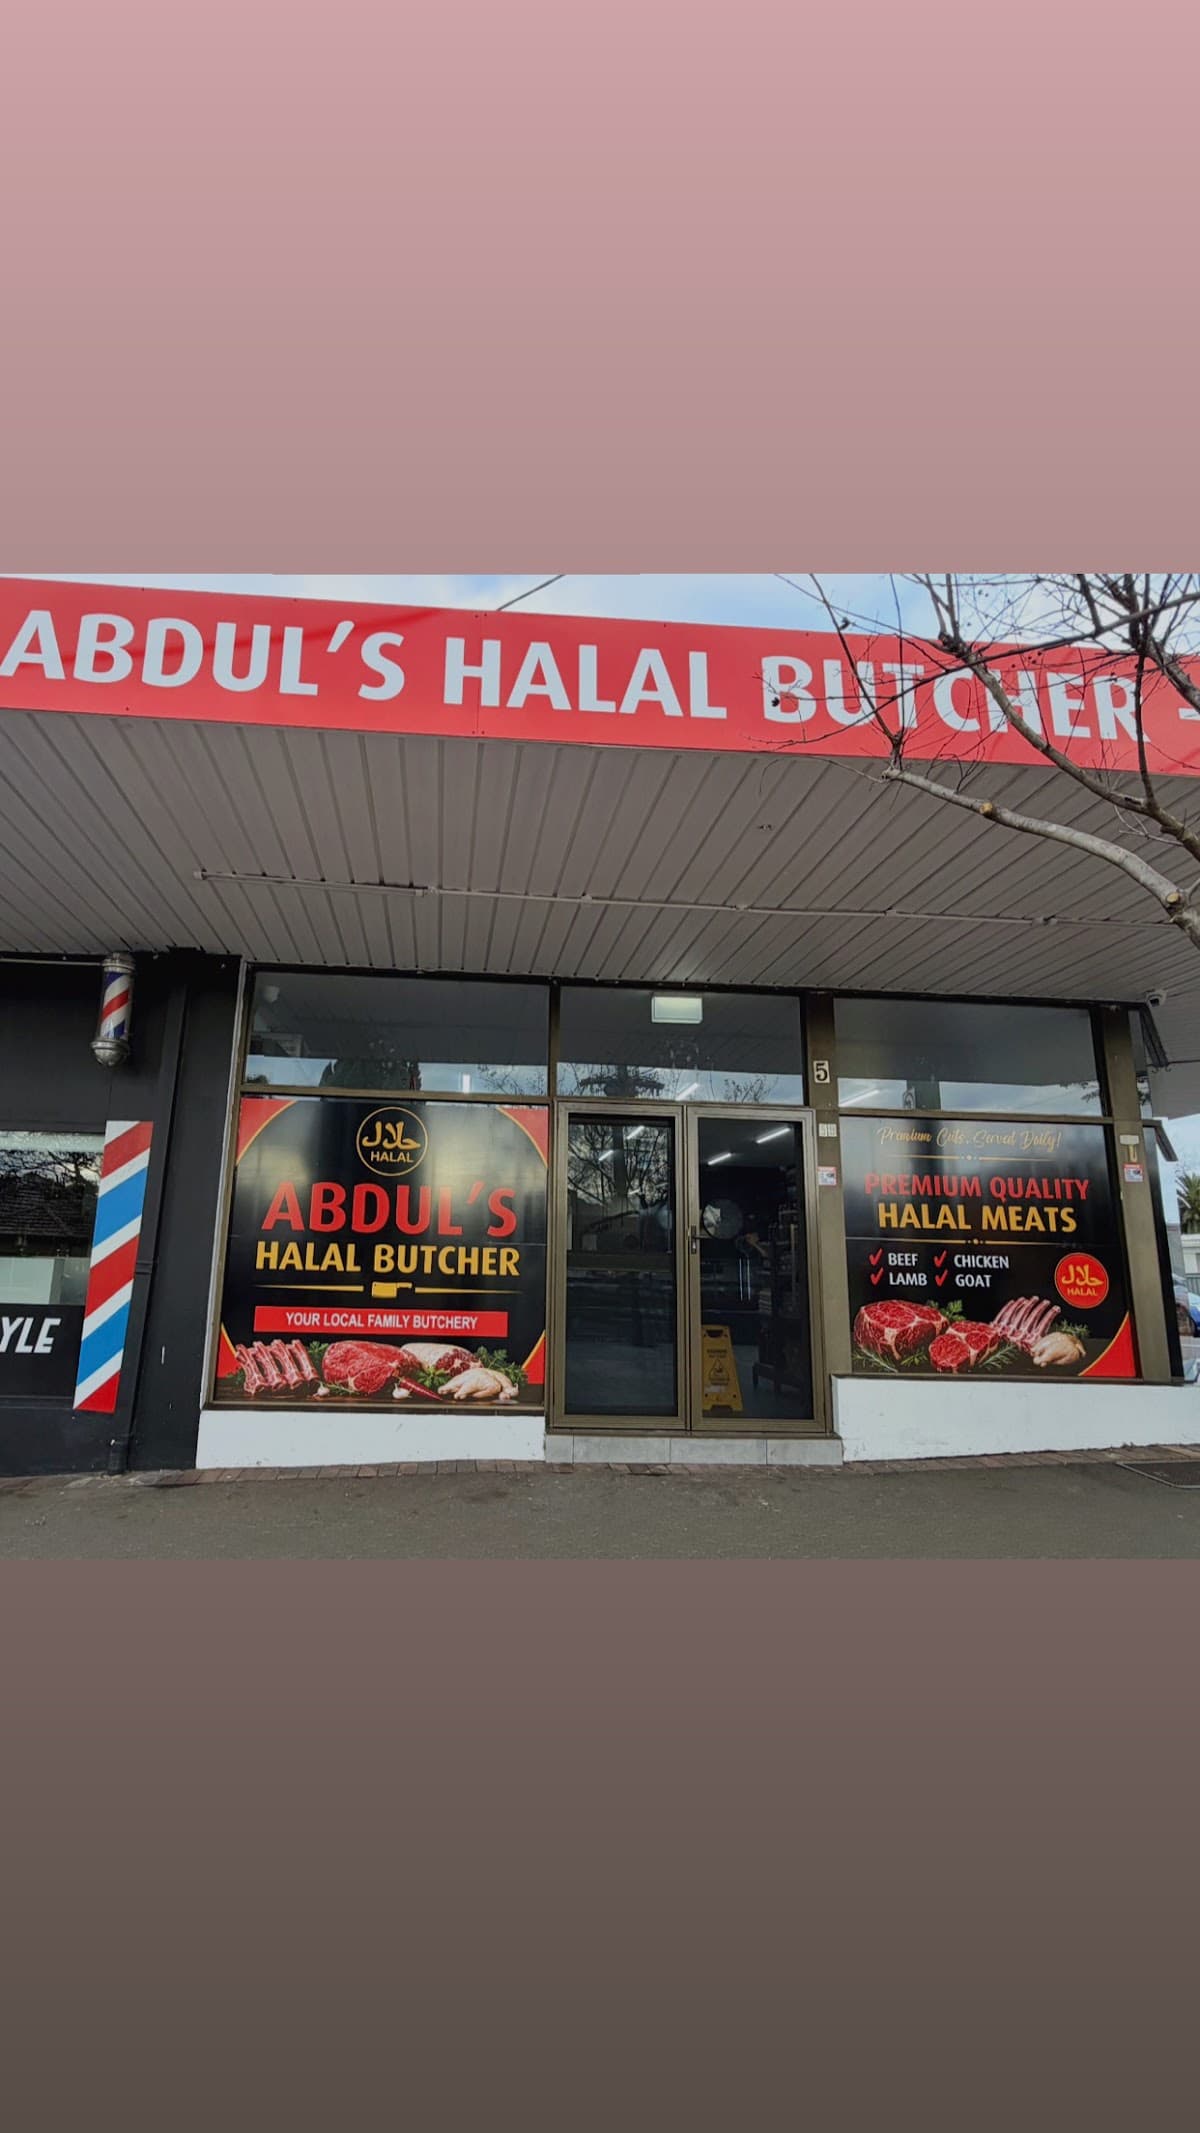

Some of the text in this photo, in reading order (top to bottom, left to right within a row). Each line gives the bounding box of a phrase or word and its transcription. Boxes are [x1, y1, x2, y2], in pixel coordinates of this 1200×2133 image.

[443, 637, 727, 720] HALAL
[761, 655, 1151, 742] BUTCHER
[815, 1062, 829, 1082] 5
[362, 1120, 422, 1150] حلال
[877, 1127, 932, 1145] Premium
[973, 1129, 1017, 1148] Served
[370, 1150, 414, 1164] HALAL
[864, 1171, 982, 1198] PREMIUM
[989, 1176, 1090, 1203] QUALITY
[878, 1202, 1077, 1233] HALAL MEATS
[255, 1240, 521, 1276] HALAL BUTCHER
[888, 1252, 919, 1267] BEEF
[953, 1254, 1010, 1269] CHICKEN
[889, 1272, 928, 1286] LAMB
[955, 1273, 992, 1288] GOAT
[1060, 1263, 1104, 1287] حلال
[1066, 1287, 1098, 1298] HALAL
[285, 1312, 478, 1330] YOUR LOCAL FAMILY BUTCHERY
[0, 1316, 62, 1353] YLE
